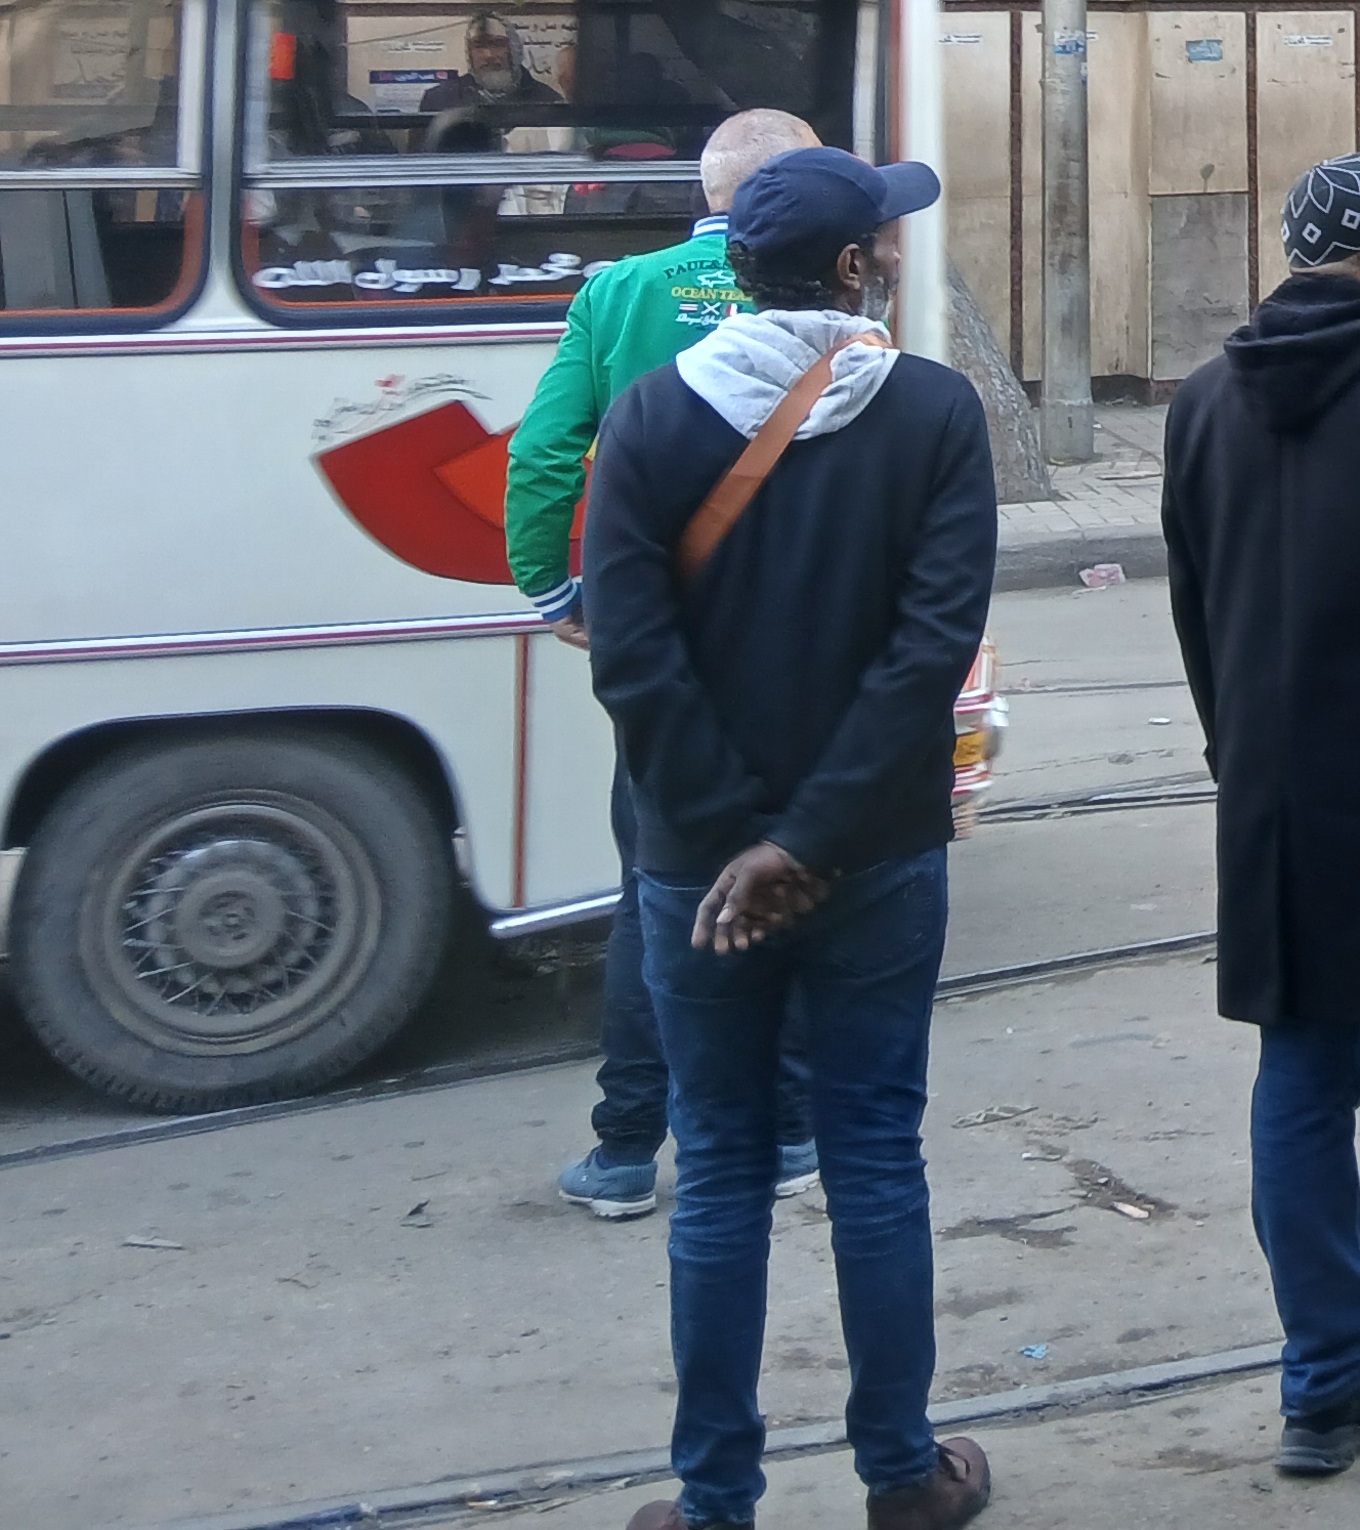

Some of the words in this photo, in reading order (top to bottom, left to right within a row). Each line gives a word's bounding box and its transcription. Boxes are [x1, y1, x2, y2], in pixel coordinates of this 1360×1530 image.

[252, 258, 352, 289] الله
[354, 258, 482, 293] رسول
[488, 252, 582, 285] محمد
[671, 286, 717, 301] OCEAN
